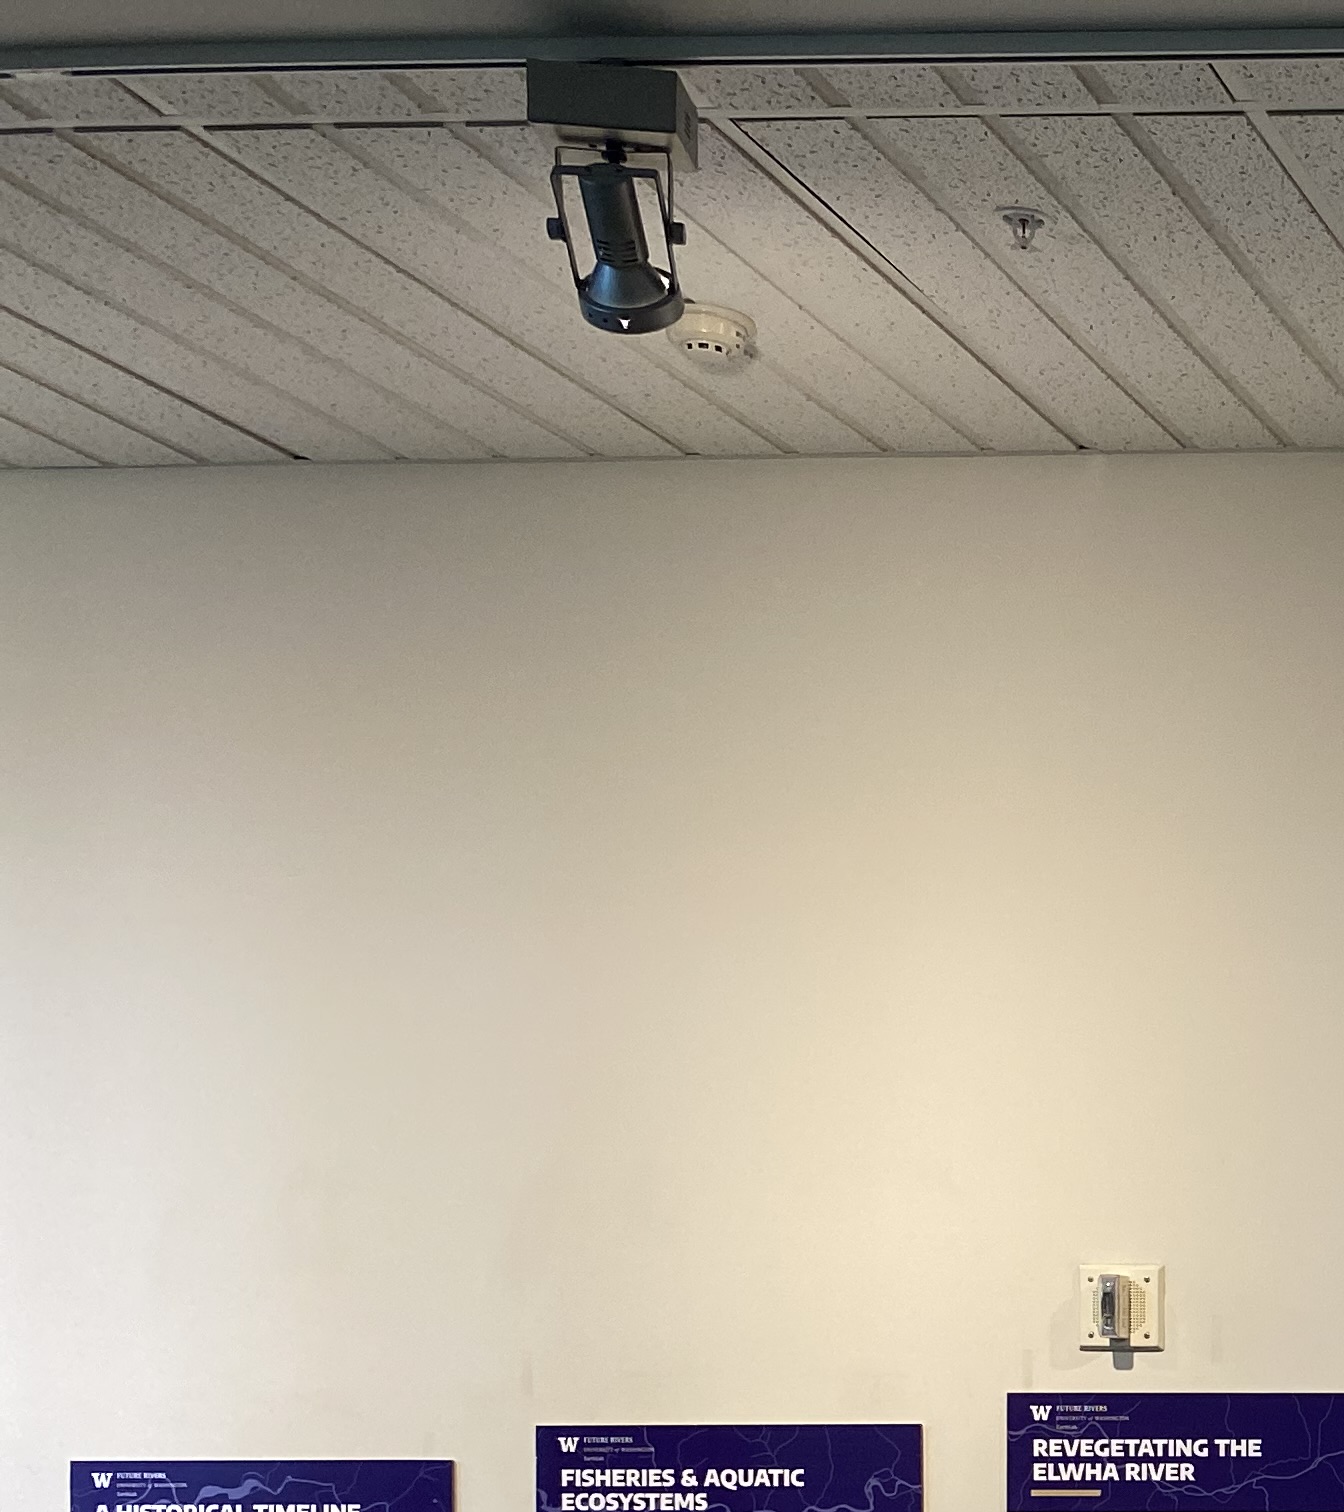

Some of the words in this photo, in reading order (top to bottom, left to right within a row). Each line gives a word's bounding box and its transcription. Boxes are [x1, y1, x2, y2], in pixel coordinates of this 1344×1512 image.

[1030, 1405, 1052, 1421] W
[558, 1437, 579, 1452] W
[583, 1436, 609, 1444] FUTURE
[609, 1436, 634, 1444] RIVERS
[1033, 1439, 1208, 1457] REVEGETATING
[1214, 1439, 1262, 1457] THE
[143, 1472, 167, 1480] RIVERS
[561, 1469, 675, 1487] FISHERIES
[681, 1469, 699, 1487] &
[704, 1469, 804, 1490] AQUATIC
[1033, 1463, 1119, 1481] ELWHA
[1125, 1463, 1195, 1481] RIVER
[91, 1473, 113, 1488] W
[562, 1493, 708, 1511] ECOSYSTEMS
